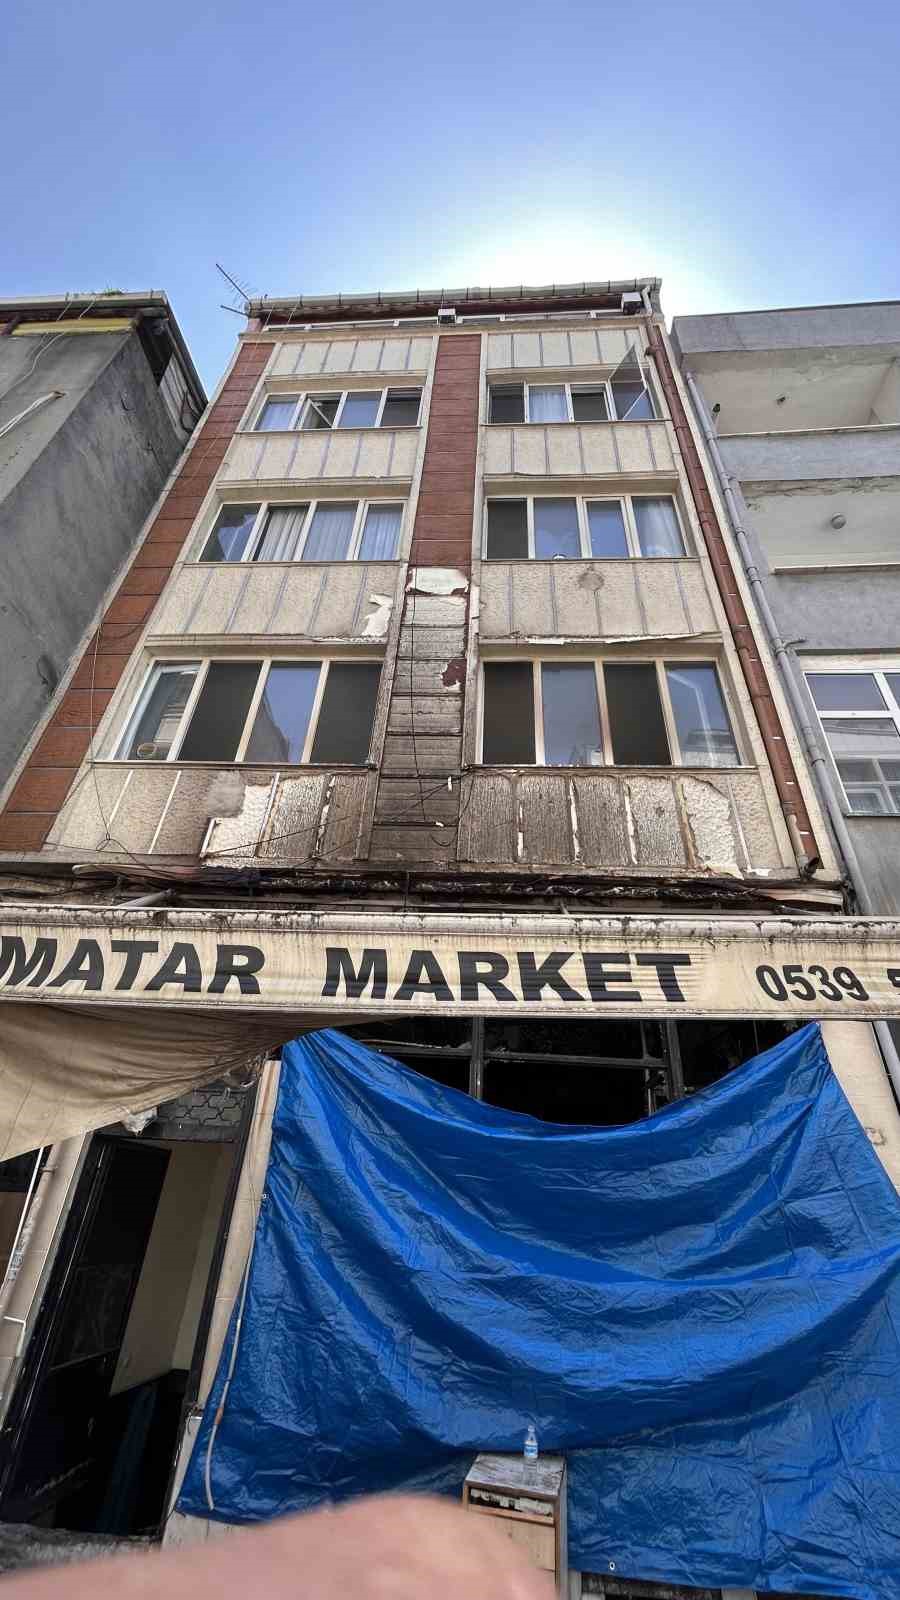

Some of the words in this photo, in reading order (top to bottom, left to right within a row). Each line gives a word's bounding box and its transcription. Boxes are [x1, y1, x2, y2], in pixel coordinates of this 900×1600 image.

[0, 935, 265, 995] MATAR
[321, 947, 692, 1003] MARKET
[755, 965, 870, 1002] 0539
